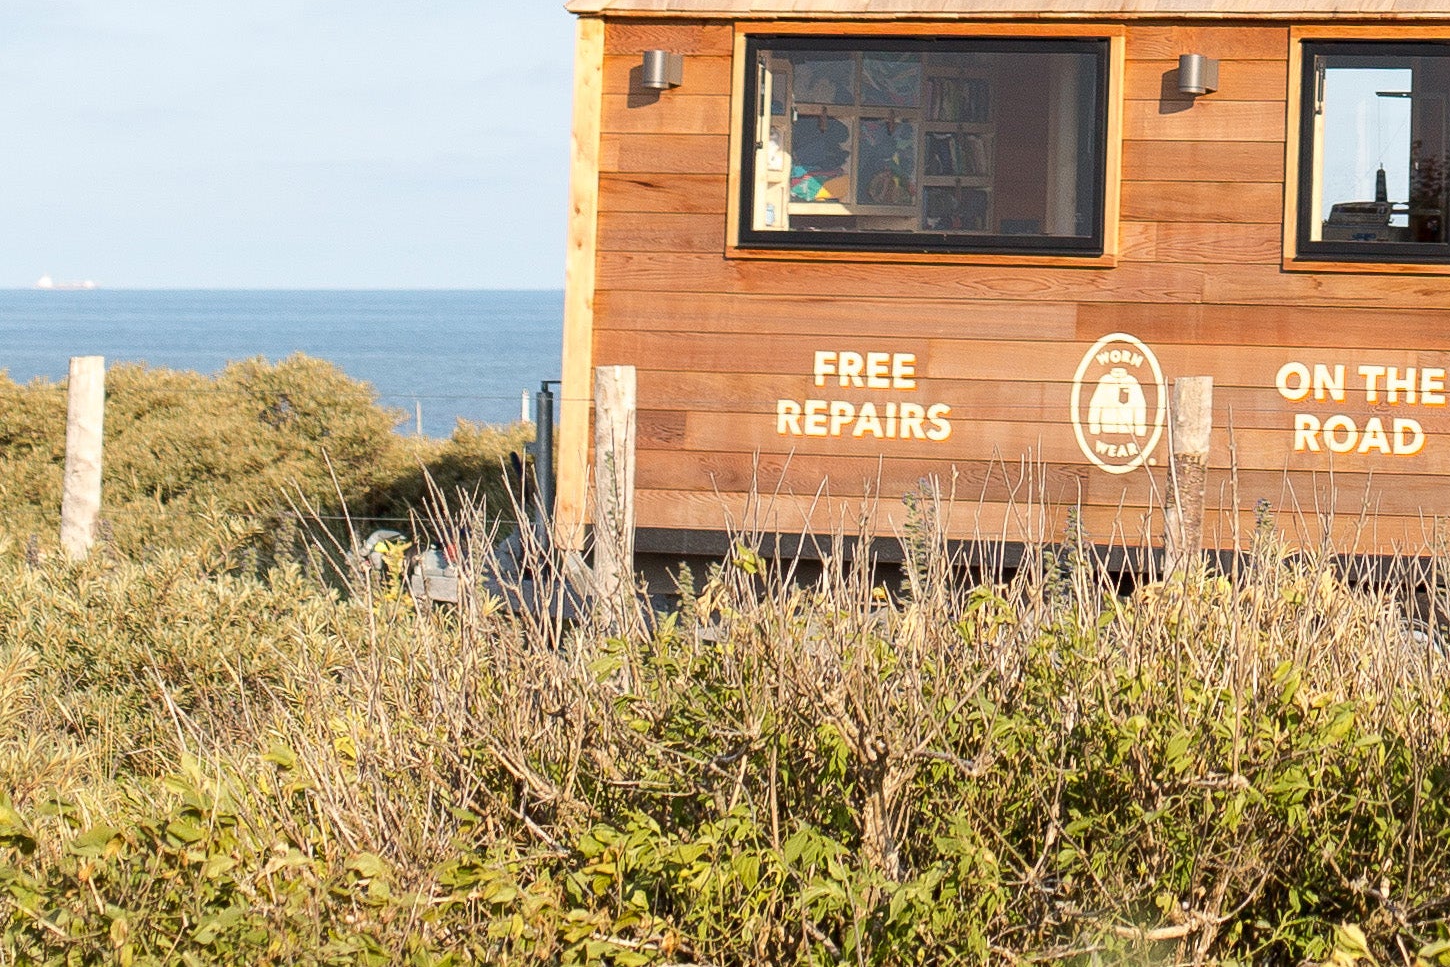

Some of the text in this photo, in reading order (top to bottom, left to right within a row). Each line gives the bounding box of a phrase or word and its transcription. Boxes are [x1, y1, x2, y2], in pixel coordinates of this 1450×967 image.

[814, 350, 917, 390] FREE
[1096, 349, 1143, 367] WORN
[1276, 362, 1447, 407] ON THE
[777, 399, 953, 442] REPAIRS
[1294, 413, 1426, 458] ROAD
[1095, 439, 1139, 458] WEAR
